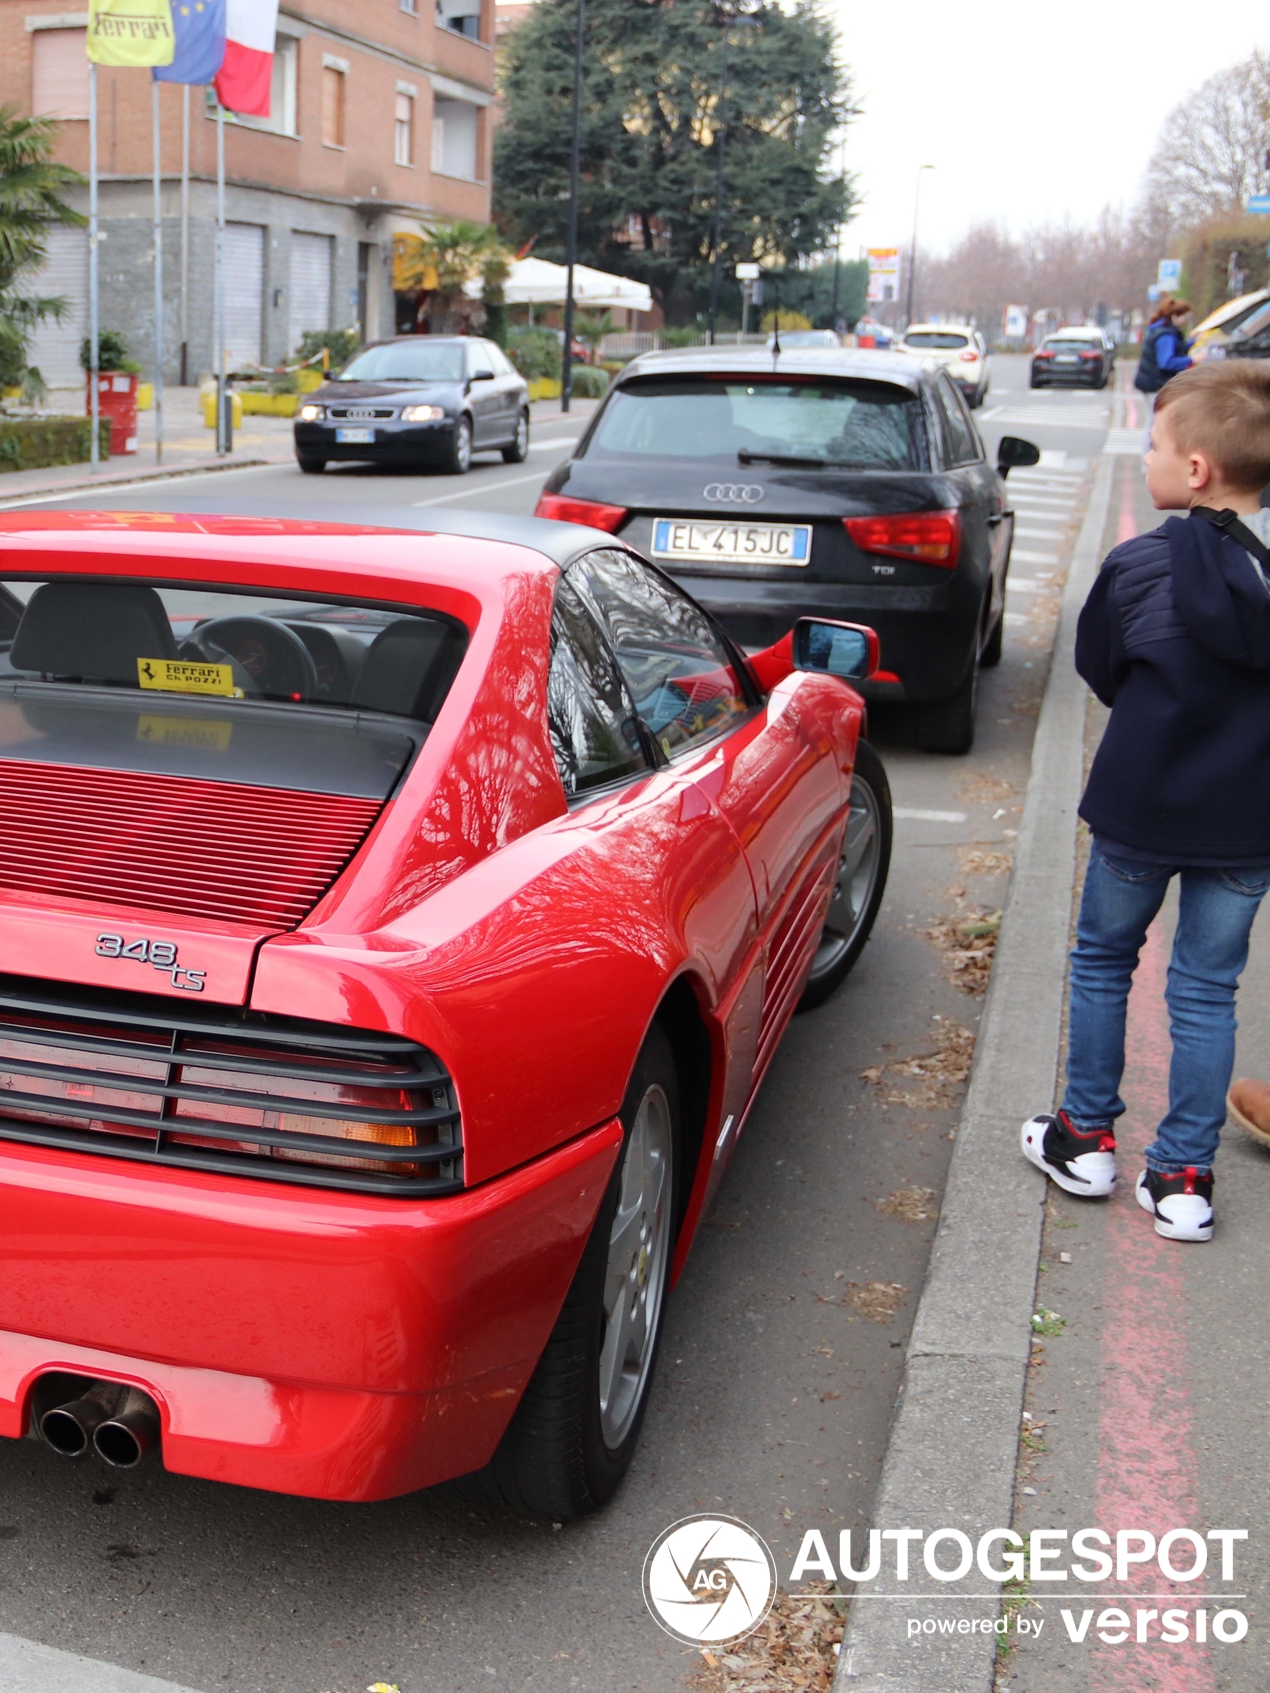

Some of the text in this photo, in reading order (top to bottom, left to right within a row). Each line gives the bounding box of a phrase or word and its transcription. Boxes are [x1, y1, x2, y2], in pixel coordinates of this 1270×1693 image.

[94, 12, 170, 39] Ferrari
[672, 526, 790, 554] EL 415JC
[872, 565, 895, 575] TDI
[166, 663, 220, 677] Ferrari
[95, 933, 178, 965] 348
[154, 963, 207, 992] ts
